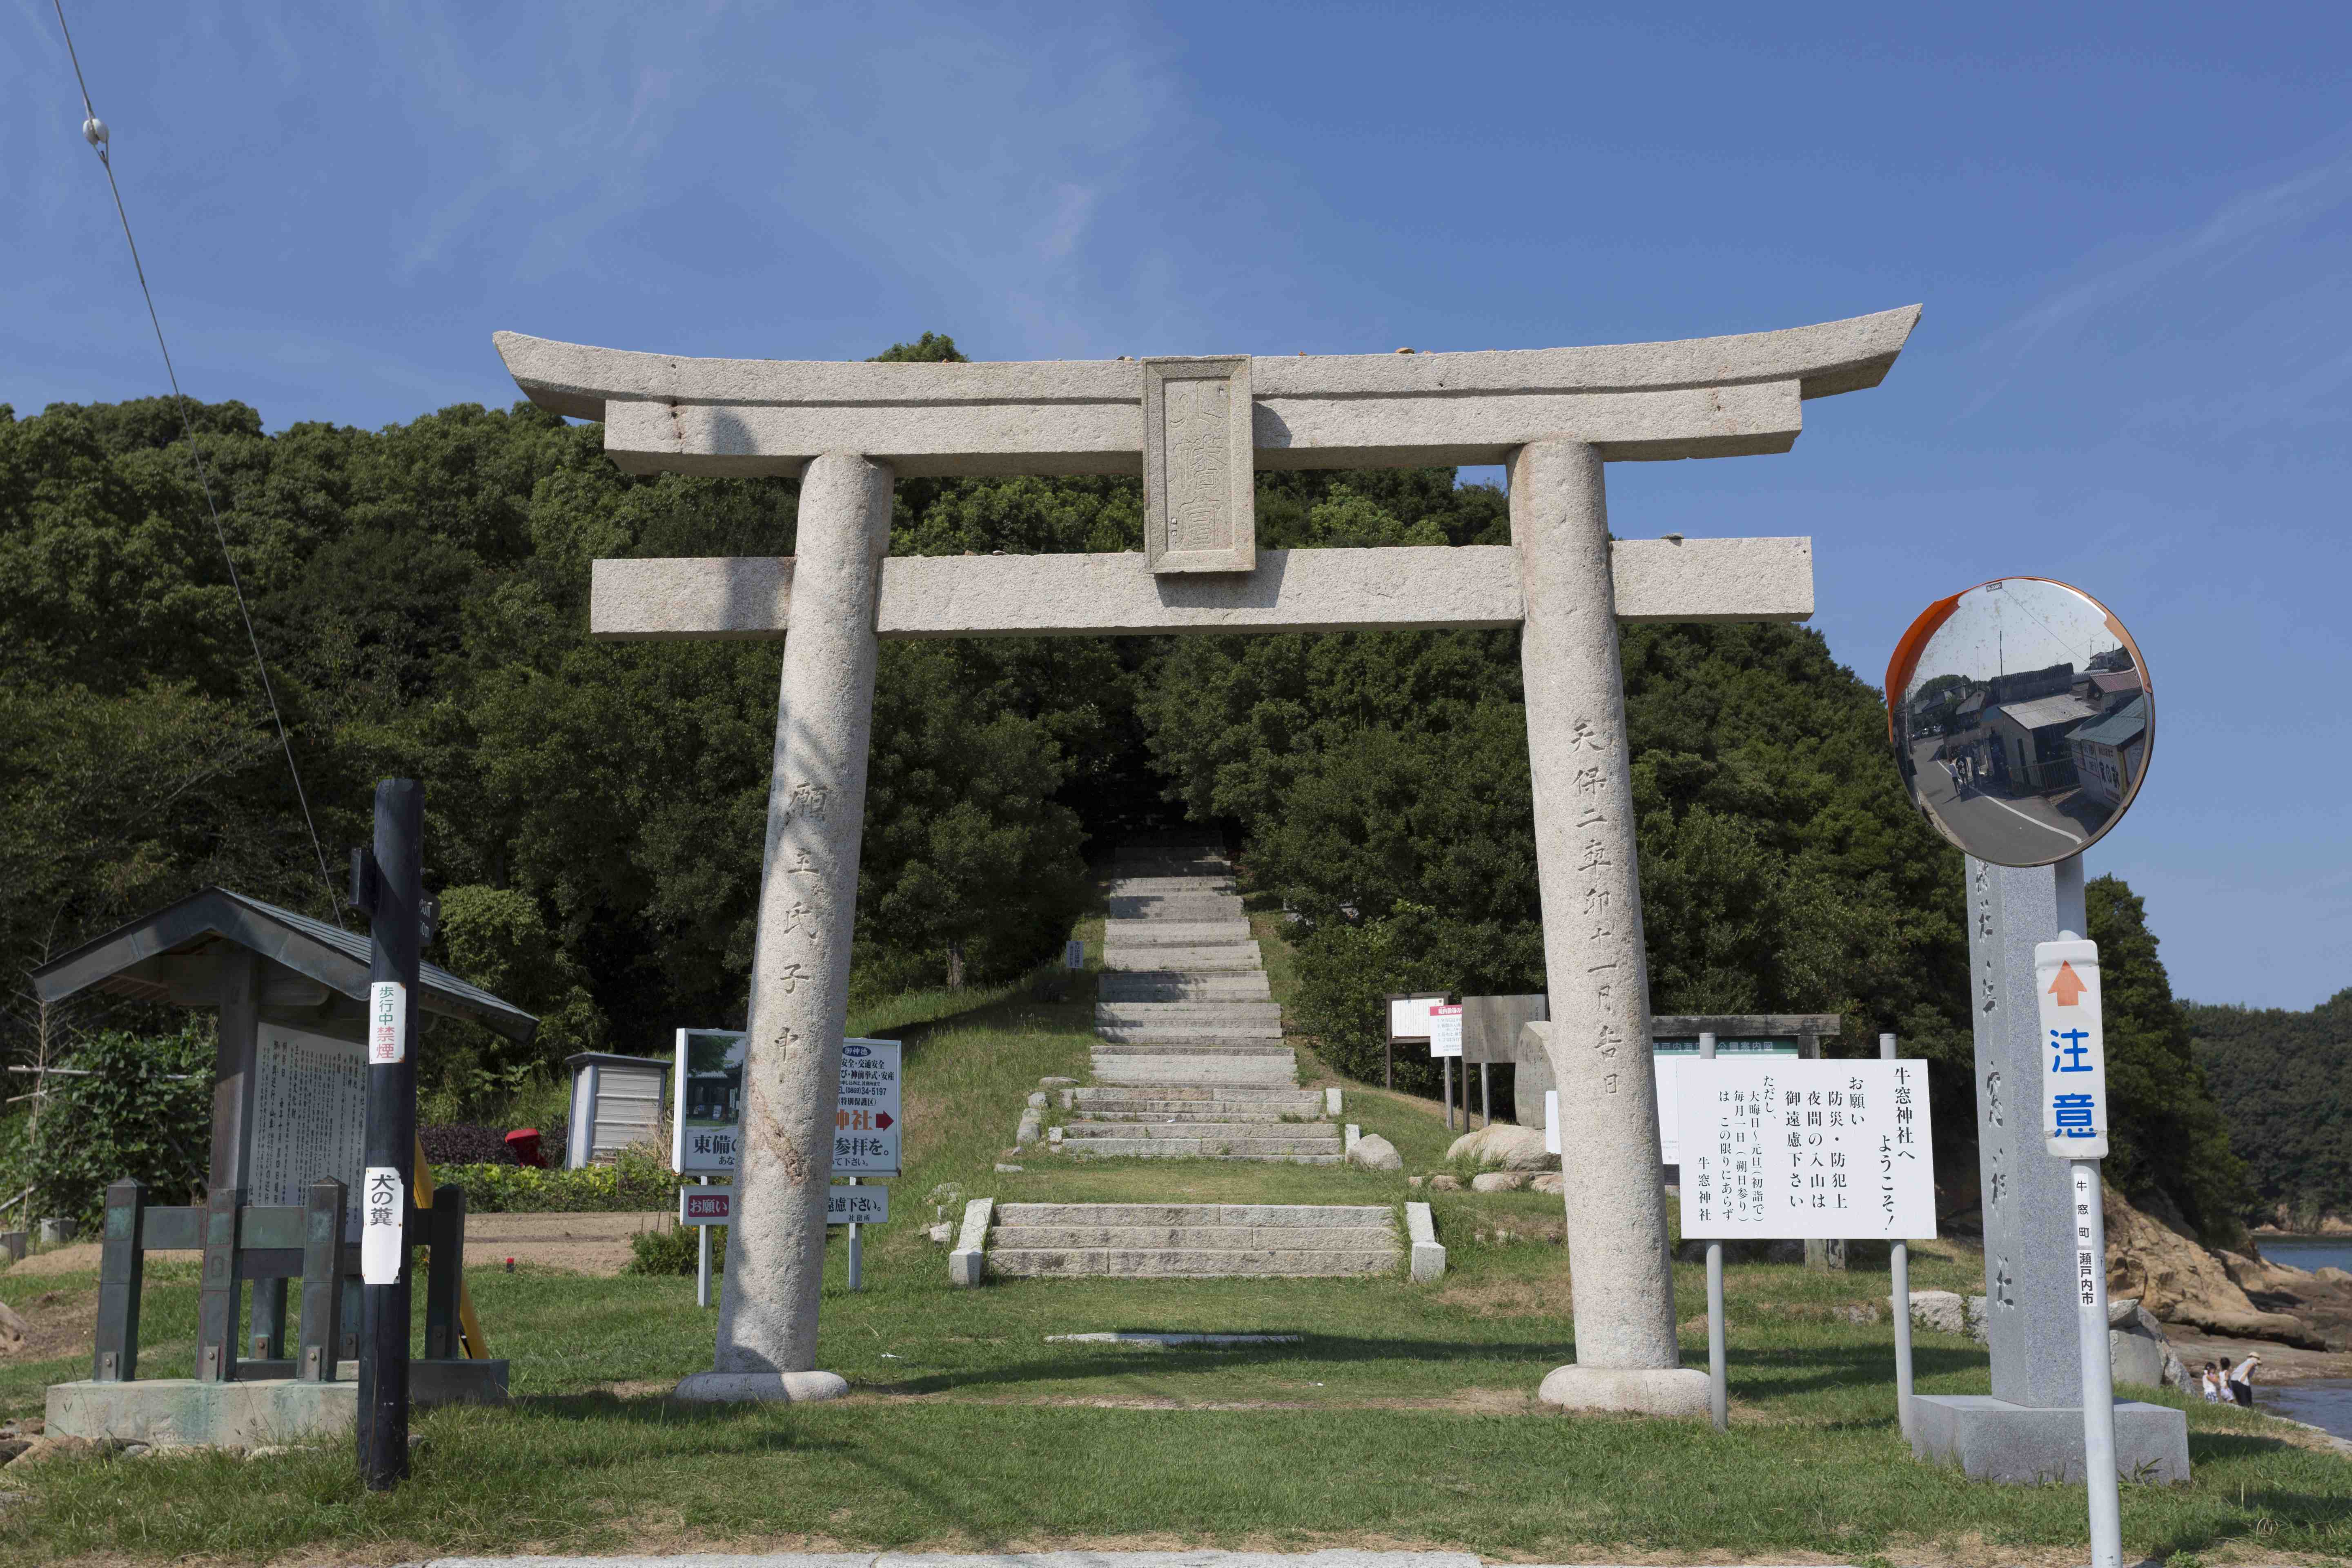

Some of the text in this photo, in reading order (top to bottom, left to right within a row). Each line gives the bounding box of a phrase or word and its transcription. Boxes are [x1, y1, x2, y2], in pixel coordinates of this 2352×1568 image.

[1764, 1075, 1776, 1119] ただし、
[1849, 1077, 1865, 1125] お願い
[2050, 1028, 2096, 1138] 注意
[1893, 1067, 1915, 1159] 牛窓神社へ
[835, 1137, 889, 1156] 参拝を。
[1785, 1091, 1804, 1207] 御遠慮下さい
[1807, 1091, 1826, 1208] 夜間の入山は
[1829, 1091, 1848, 1209] 防災・防犯上
[370, 1174, 395, 1226] 犬の糞
[690, 1199, 727, 1213] お願い
[1697, 1156, 1711, 1221] 牛窓神社
[2076, 1180, 2090, 1238] 牛窓町
[2079, 1252, 2094, 1305] 瀬戸内市
